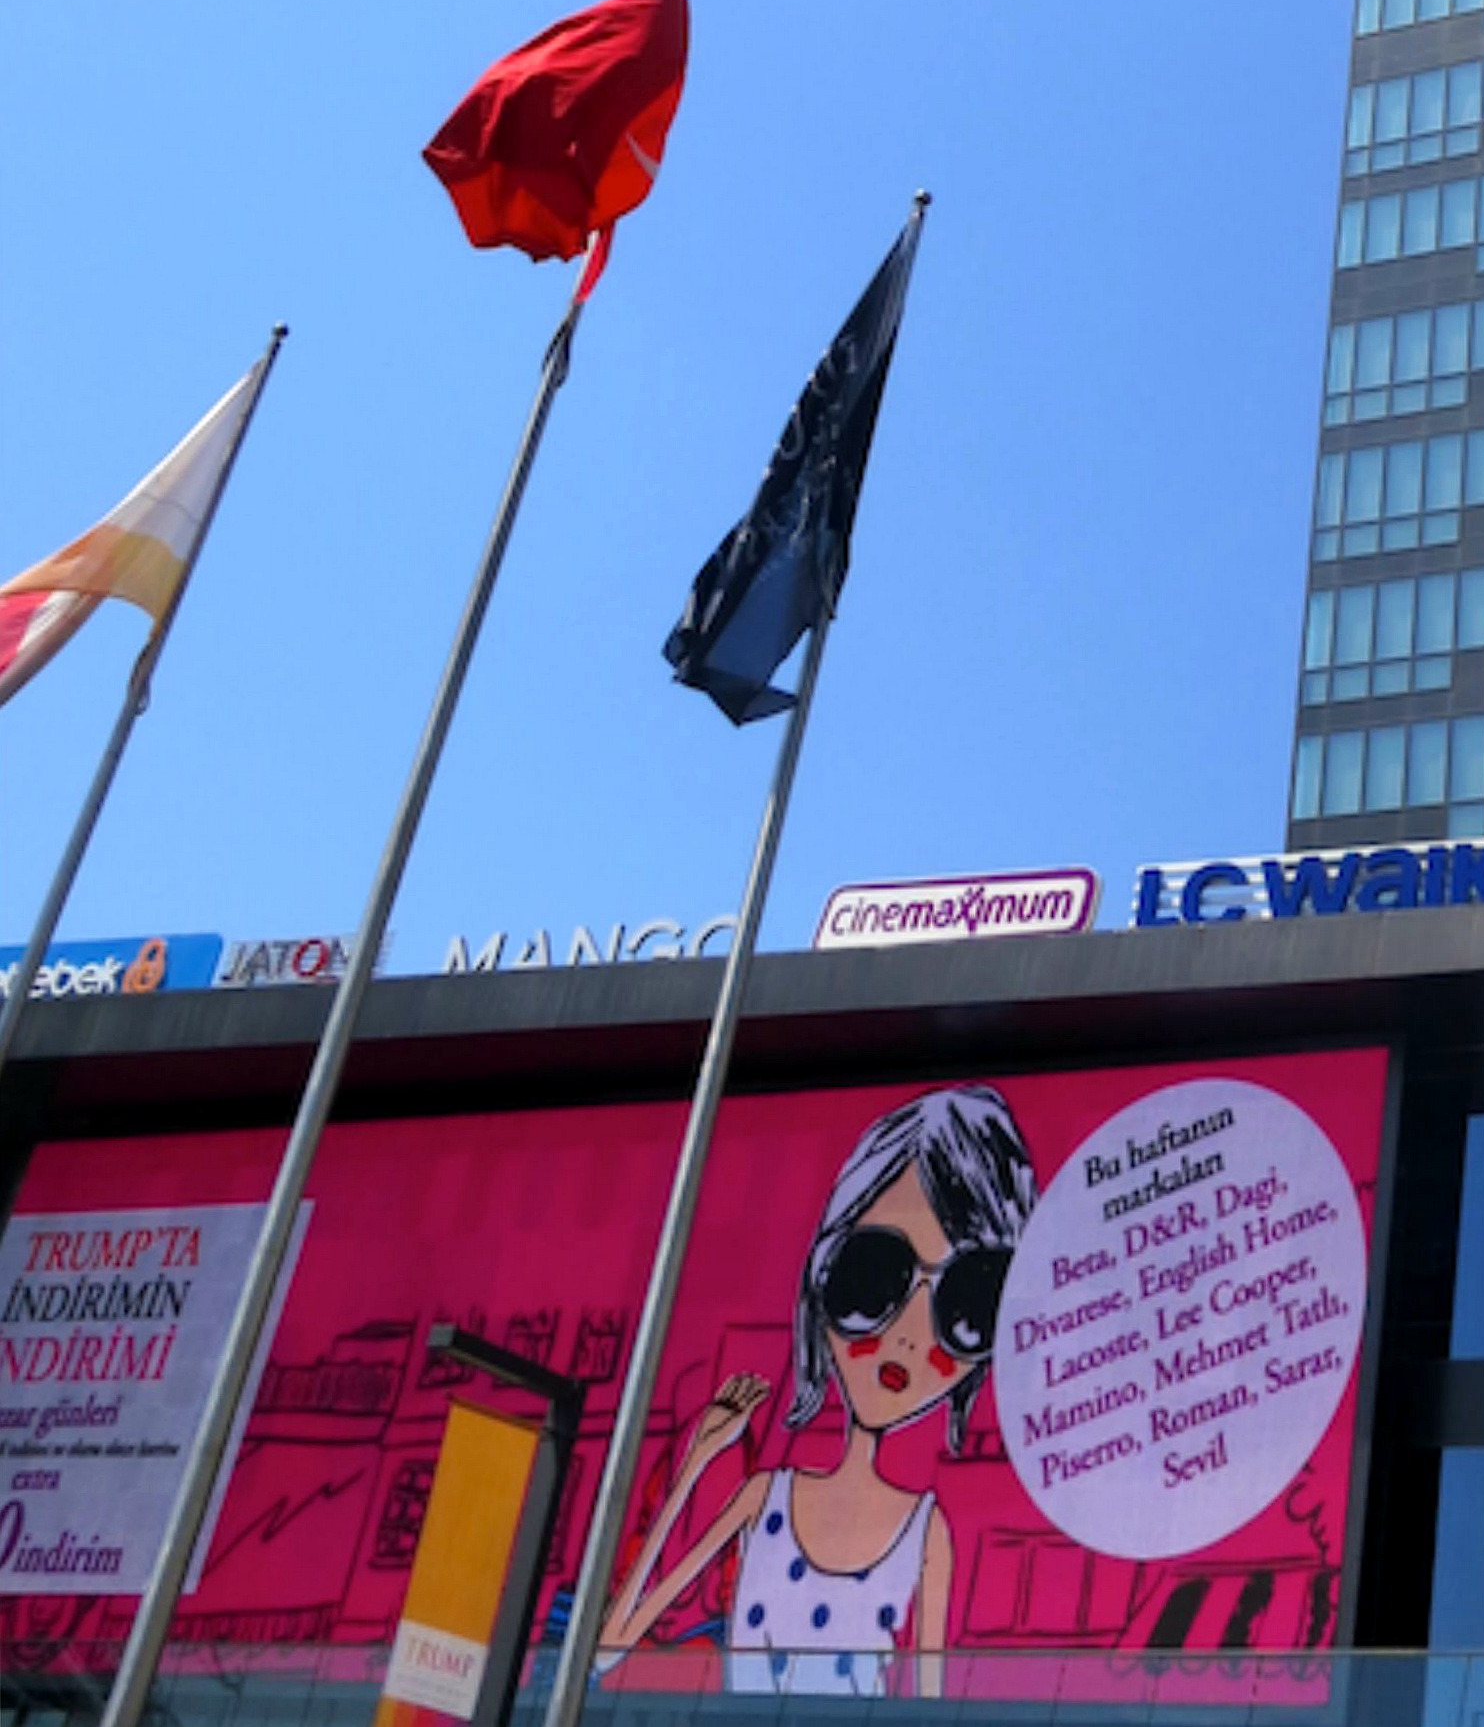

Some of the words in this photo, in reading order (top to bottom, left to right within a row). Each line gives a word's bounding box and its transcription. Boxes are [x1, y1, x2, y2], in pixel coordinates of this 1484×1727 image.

[830, 886, 1074, 934] cinemaximum
[1136, 862, 1250, 927] LC
[1085, 1155, 1120, 1188] Bu
[24, 1226, 201, 1272] TRUMP'TA
[1052, 1250, 1117, 1290] Beta,
[1123, 1201, 1207, 1258] D&R,
[1, 1273, 192, 1322] İNDİRİMİN
[1013, 1290, 1132, 1354] Divarese,
[1139, 1232, 1237, 1299] English
[1243, 1201, 1338, 1252] Home,
[1044, 1330, 1148, 1387] Lacoste,
[1155, 1303, 1202, 1340] Lee
[1210, 1256, 1316, 1315] Cooper,
[1022, 1381, 1146, 1446] Mamino,
[1154, 1324, 1268, 1391] Mehmet
[1150, 1377, 1258, 1442] Roman,
[1264, 1346, 1342, 1393] Sarar,
[1163, 1430, 1229, 1489] Sevil
[13, 1529, 123, 1573] indirim
[404, 1635, 476, 1678] TRUMP
